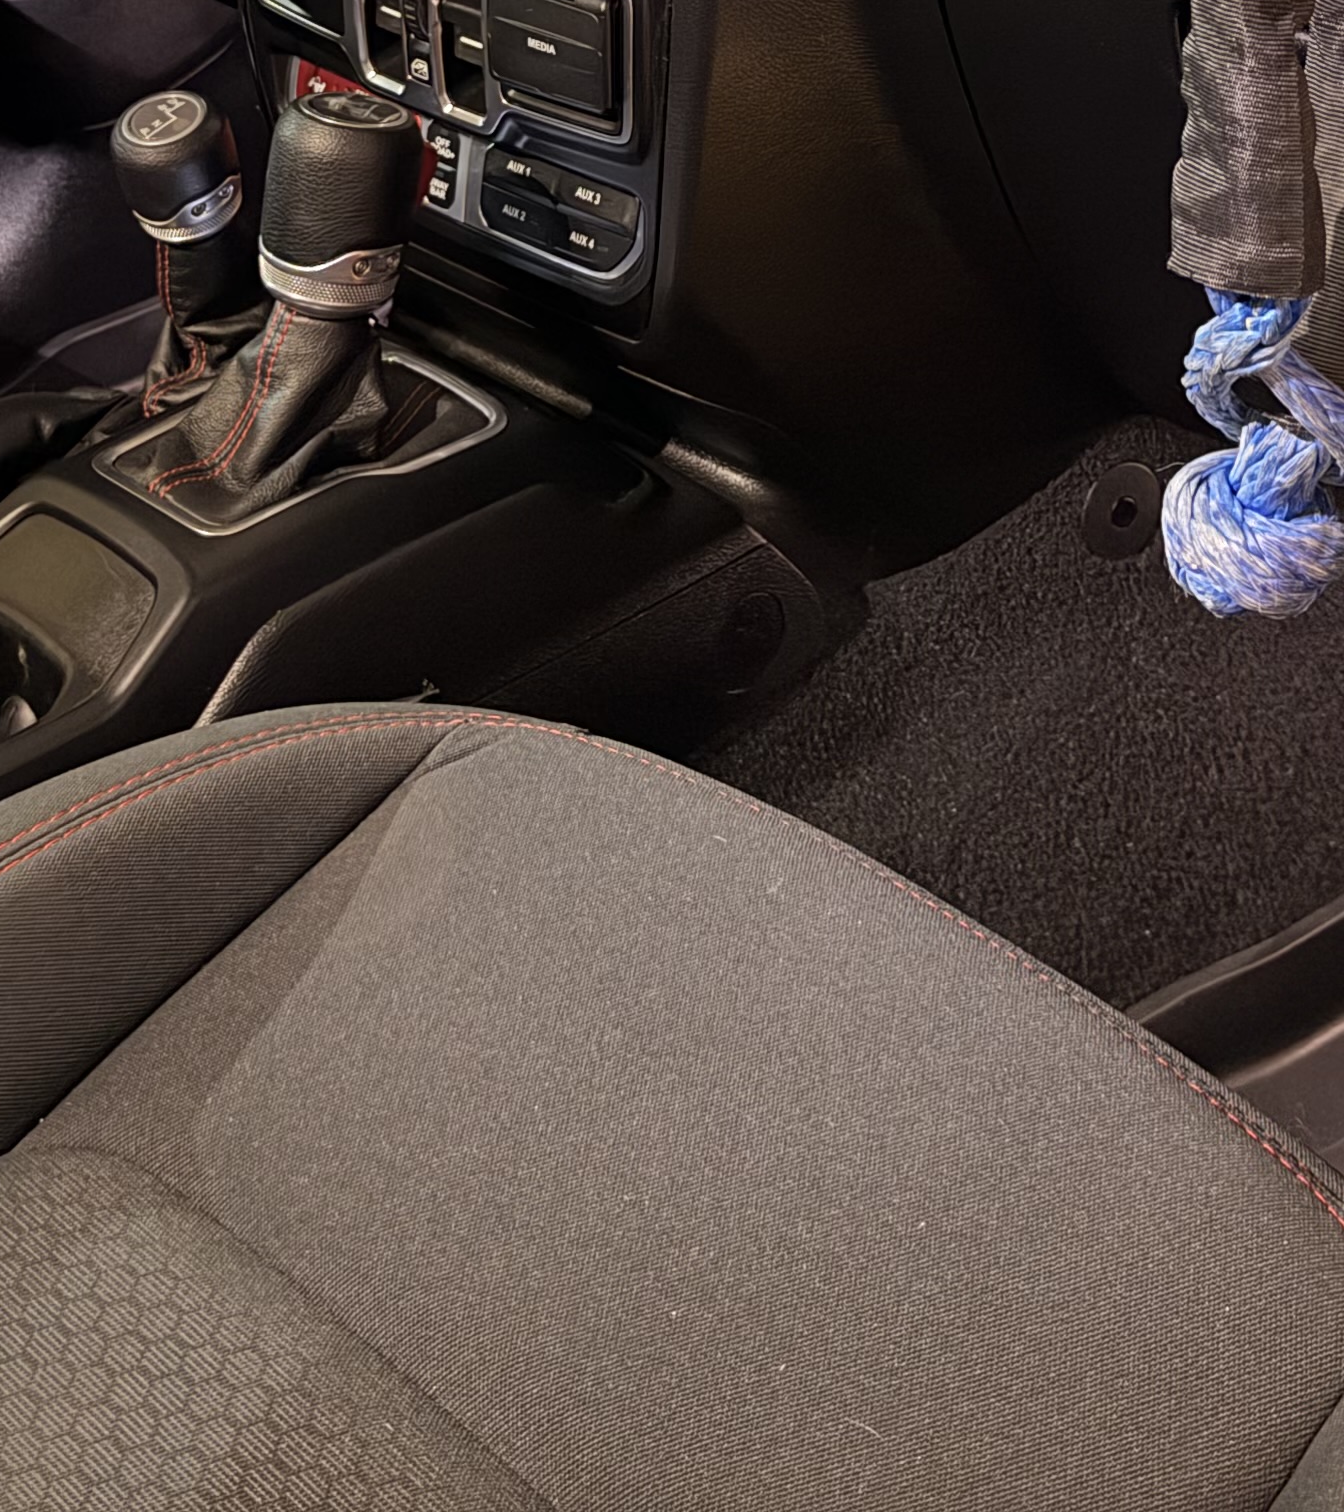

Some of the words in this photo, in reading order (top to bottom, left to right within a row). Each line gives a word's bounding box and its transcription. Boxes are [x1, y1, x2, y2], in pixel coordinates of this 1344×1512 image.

[527, 36, 557, 56] MEDIA
[434, 135, 452, 148] OFF
[506, 159, 526, 176] AUX
[575, 186, 594, 204] AUX
[502, 203, 520, 221] AUX
[569, 230, 588, 248] AUX
